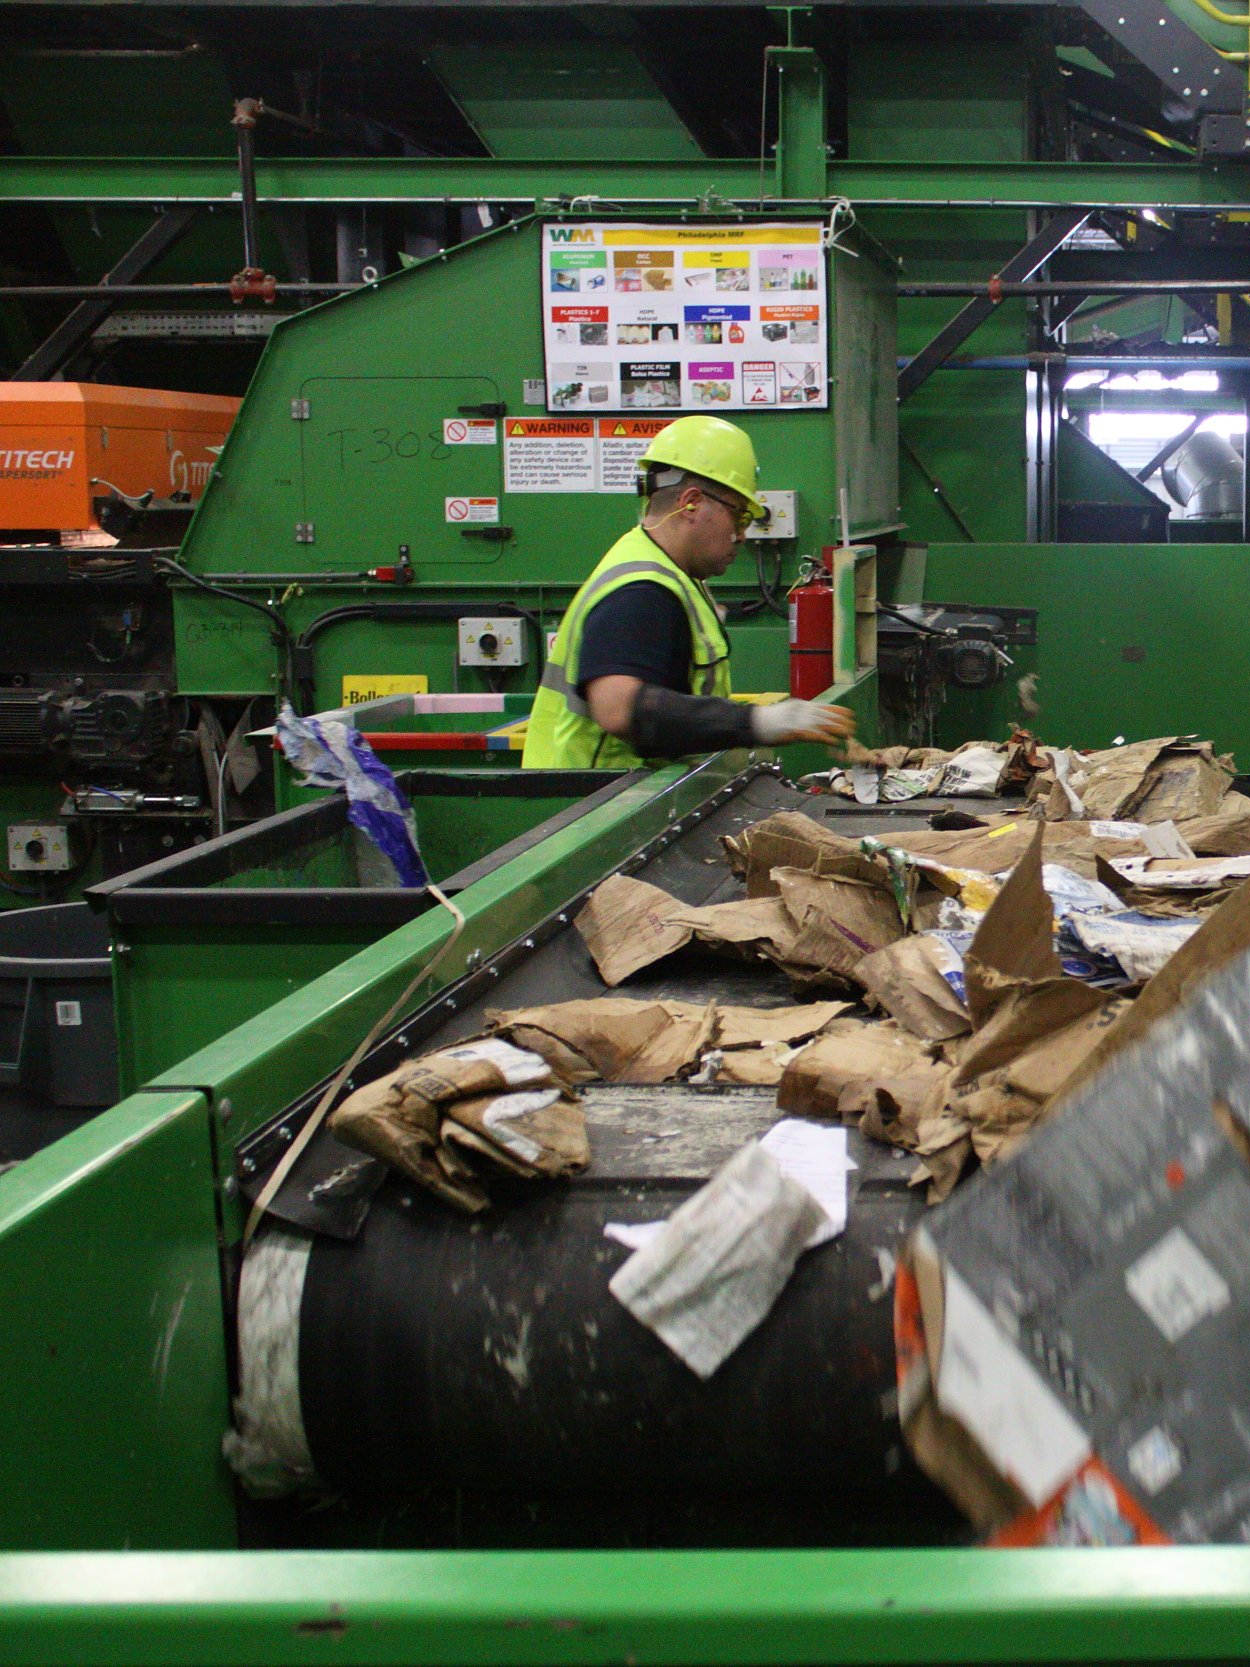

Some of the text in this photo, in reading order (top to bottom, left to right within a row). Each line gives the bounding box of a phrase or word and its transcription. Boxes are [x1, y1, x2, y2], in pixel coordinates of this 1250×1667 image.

[549, 229, 595, 242] WM
[678, 231, 726, 239] Philadelphia
[527, 423, 590, 433] WARNING
[632, 422, 668, 434] AVIS
